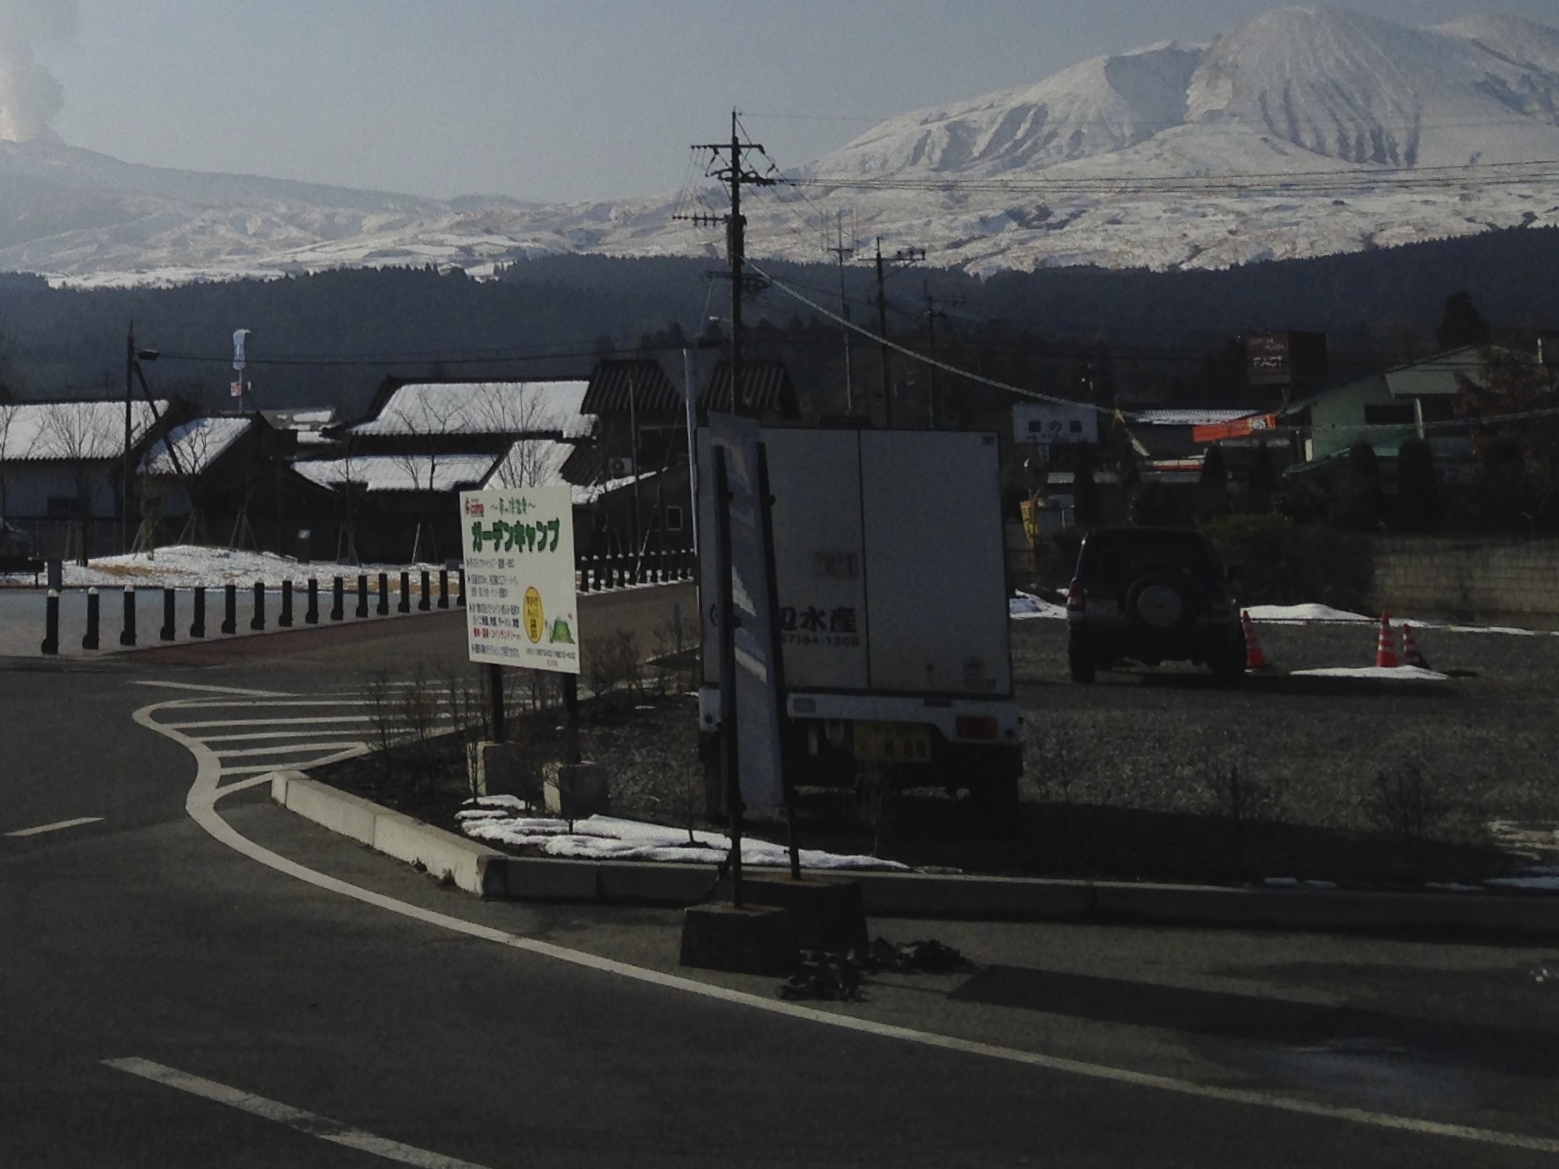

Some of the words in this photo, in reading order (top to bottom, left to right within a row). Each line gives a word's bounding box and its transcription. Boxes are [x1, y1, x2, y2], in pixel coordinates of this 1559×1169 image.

[472, 517, 560, 553] ガーデンキャンプ
